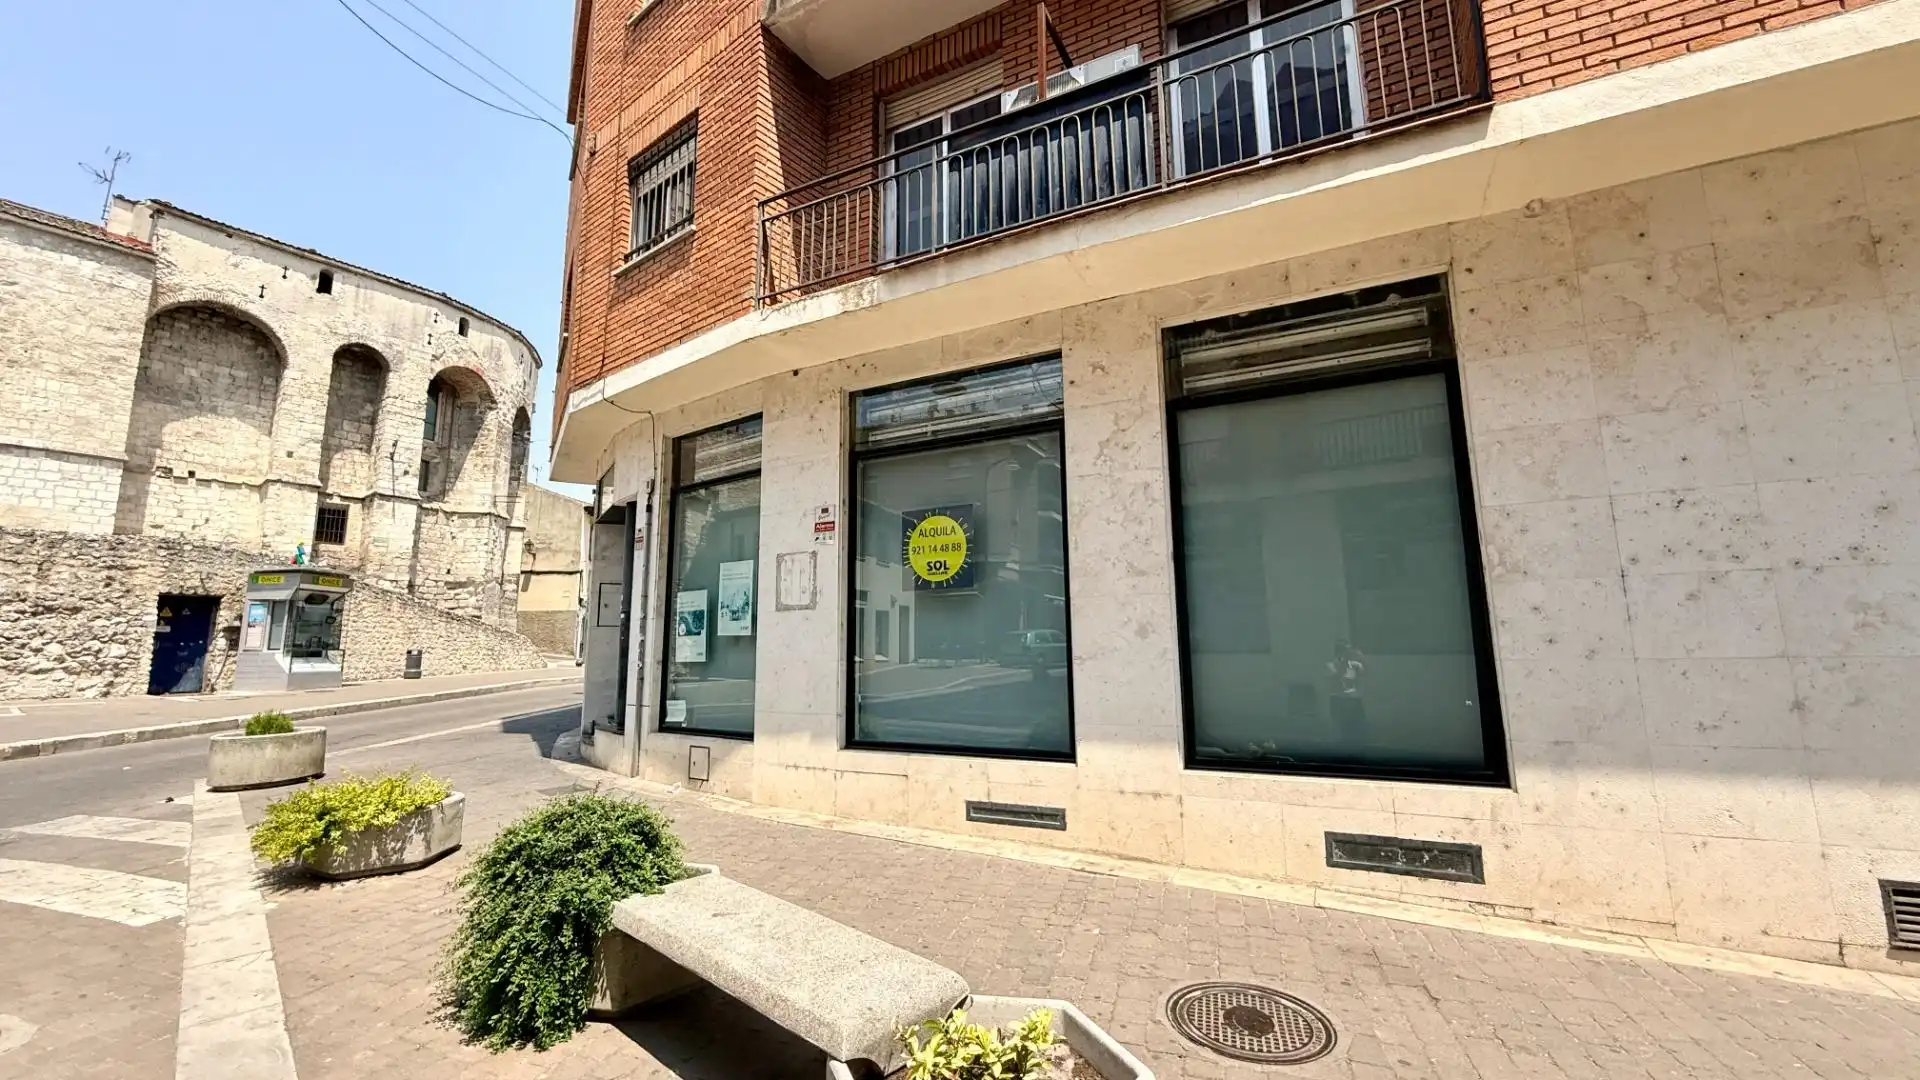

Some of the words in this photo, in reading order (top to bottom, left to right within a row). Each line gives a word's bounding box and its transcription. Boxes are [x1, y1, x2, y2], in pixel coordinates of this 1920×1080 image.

[918, 526, 956, 538] ALQUILA
[911, 546, 925, 555] 921
[928, 545, 938, 553] 14
[939, 544, 950, 553] 48
[951, 542, 962, 552] 88
[926, 560, 949, 572] SOL
